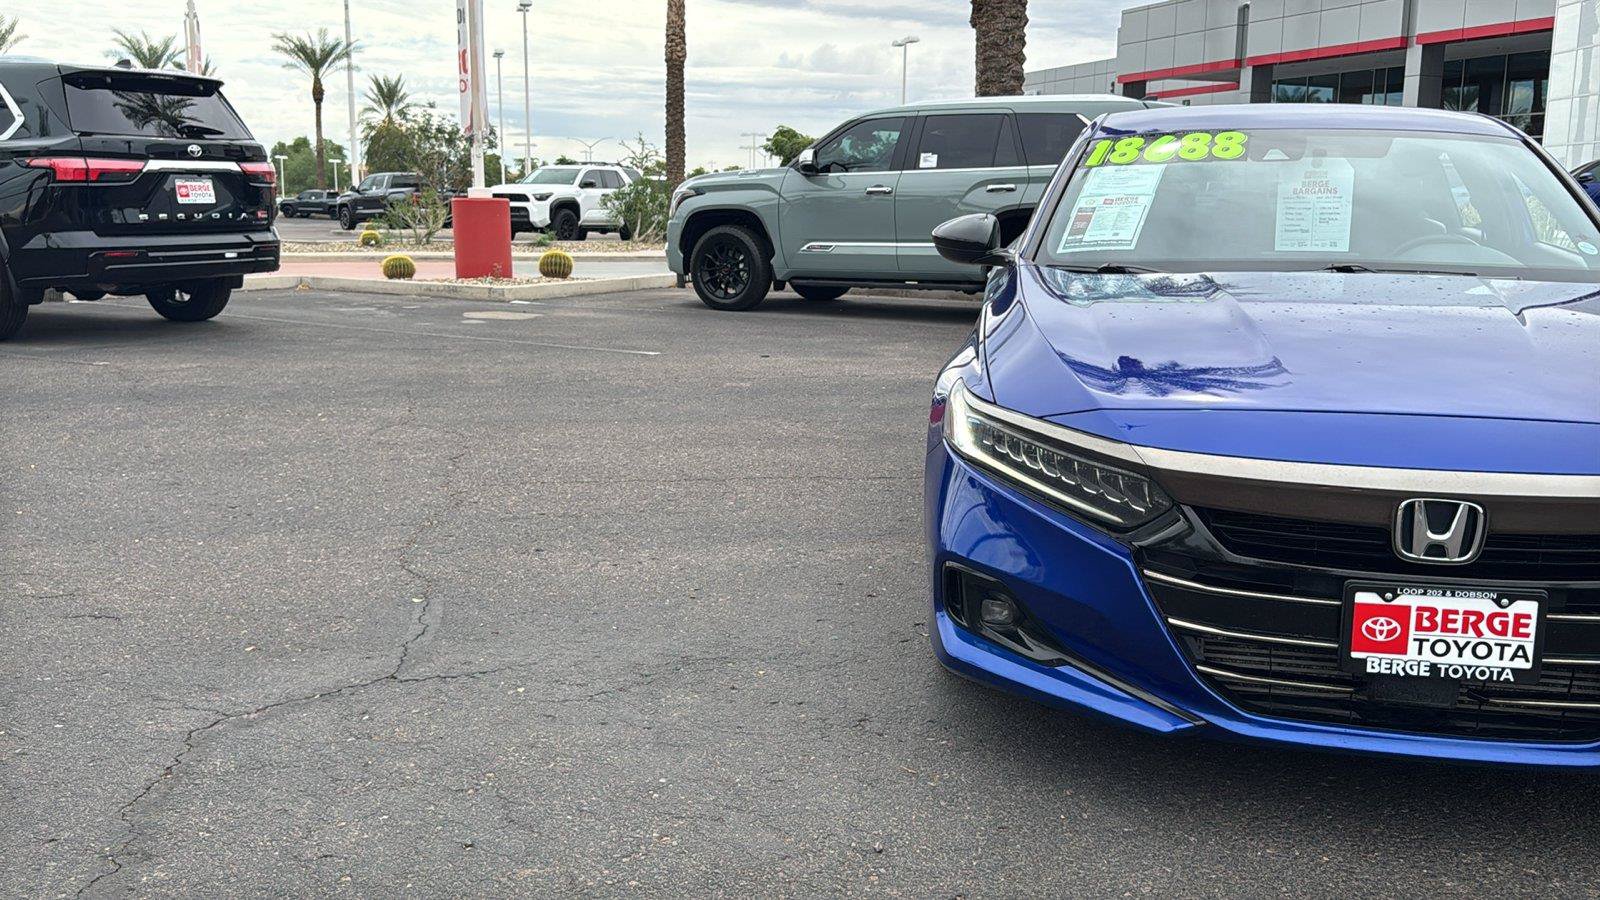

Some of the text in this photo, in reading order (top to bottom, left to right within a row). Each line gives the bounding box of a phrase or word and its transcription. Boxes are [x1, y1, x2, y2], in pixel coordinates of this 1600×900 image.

[1085, 131, 1248, 167] 18688
[189, 184, 212, 192] BERGE
[1301, 180, 1330, 188] BERGE
[1292, 187, 1338, 195] BARGAINS
[138, 212, 249, 221] SEQUOIA
[1397, 587, 1424, 596] LOOP
[1426, 589, 1442, 597] 202
[1455, 590, 1498, 600] DOBSON
[1415, 606, 1532, 638] BERGE
[1413, 638, 1530, 663] TOYOTA
[1366, 656, 1515, 682] BERGE TOYOTA
